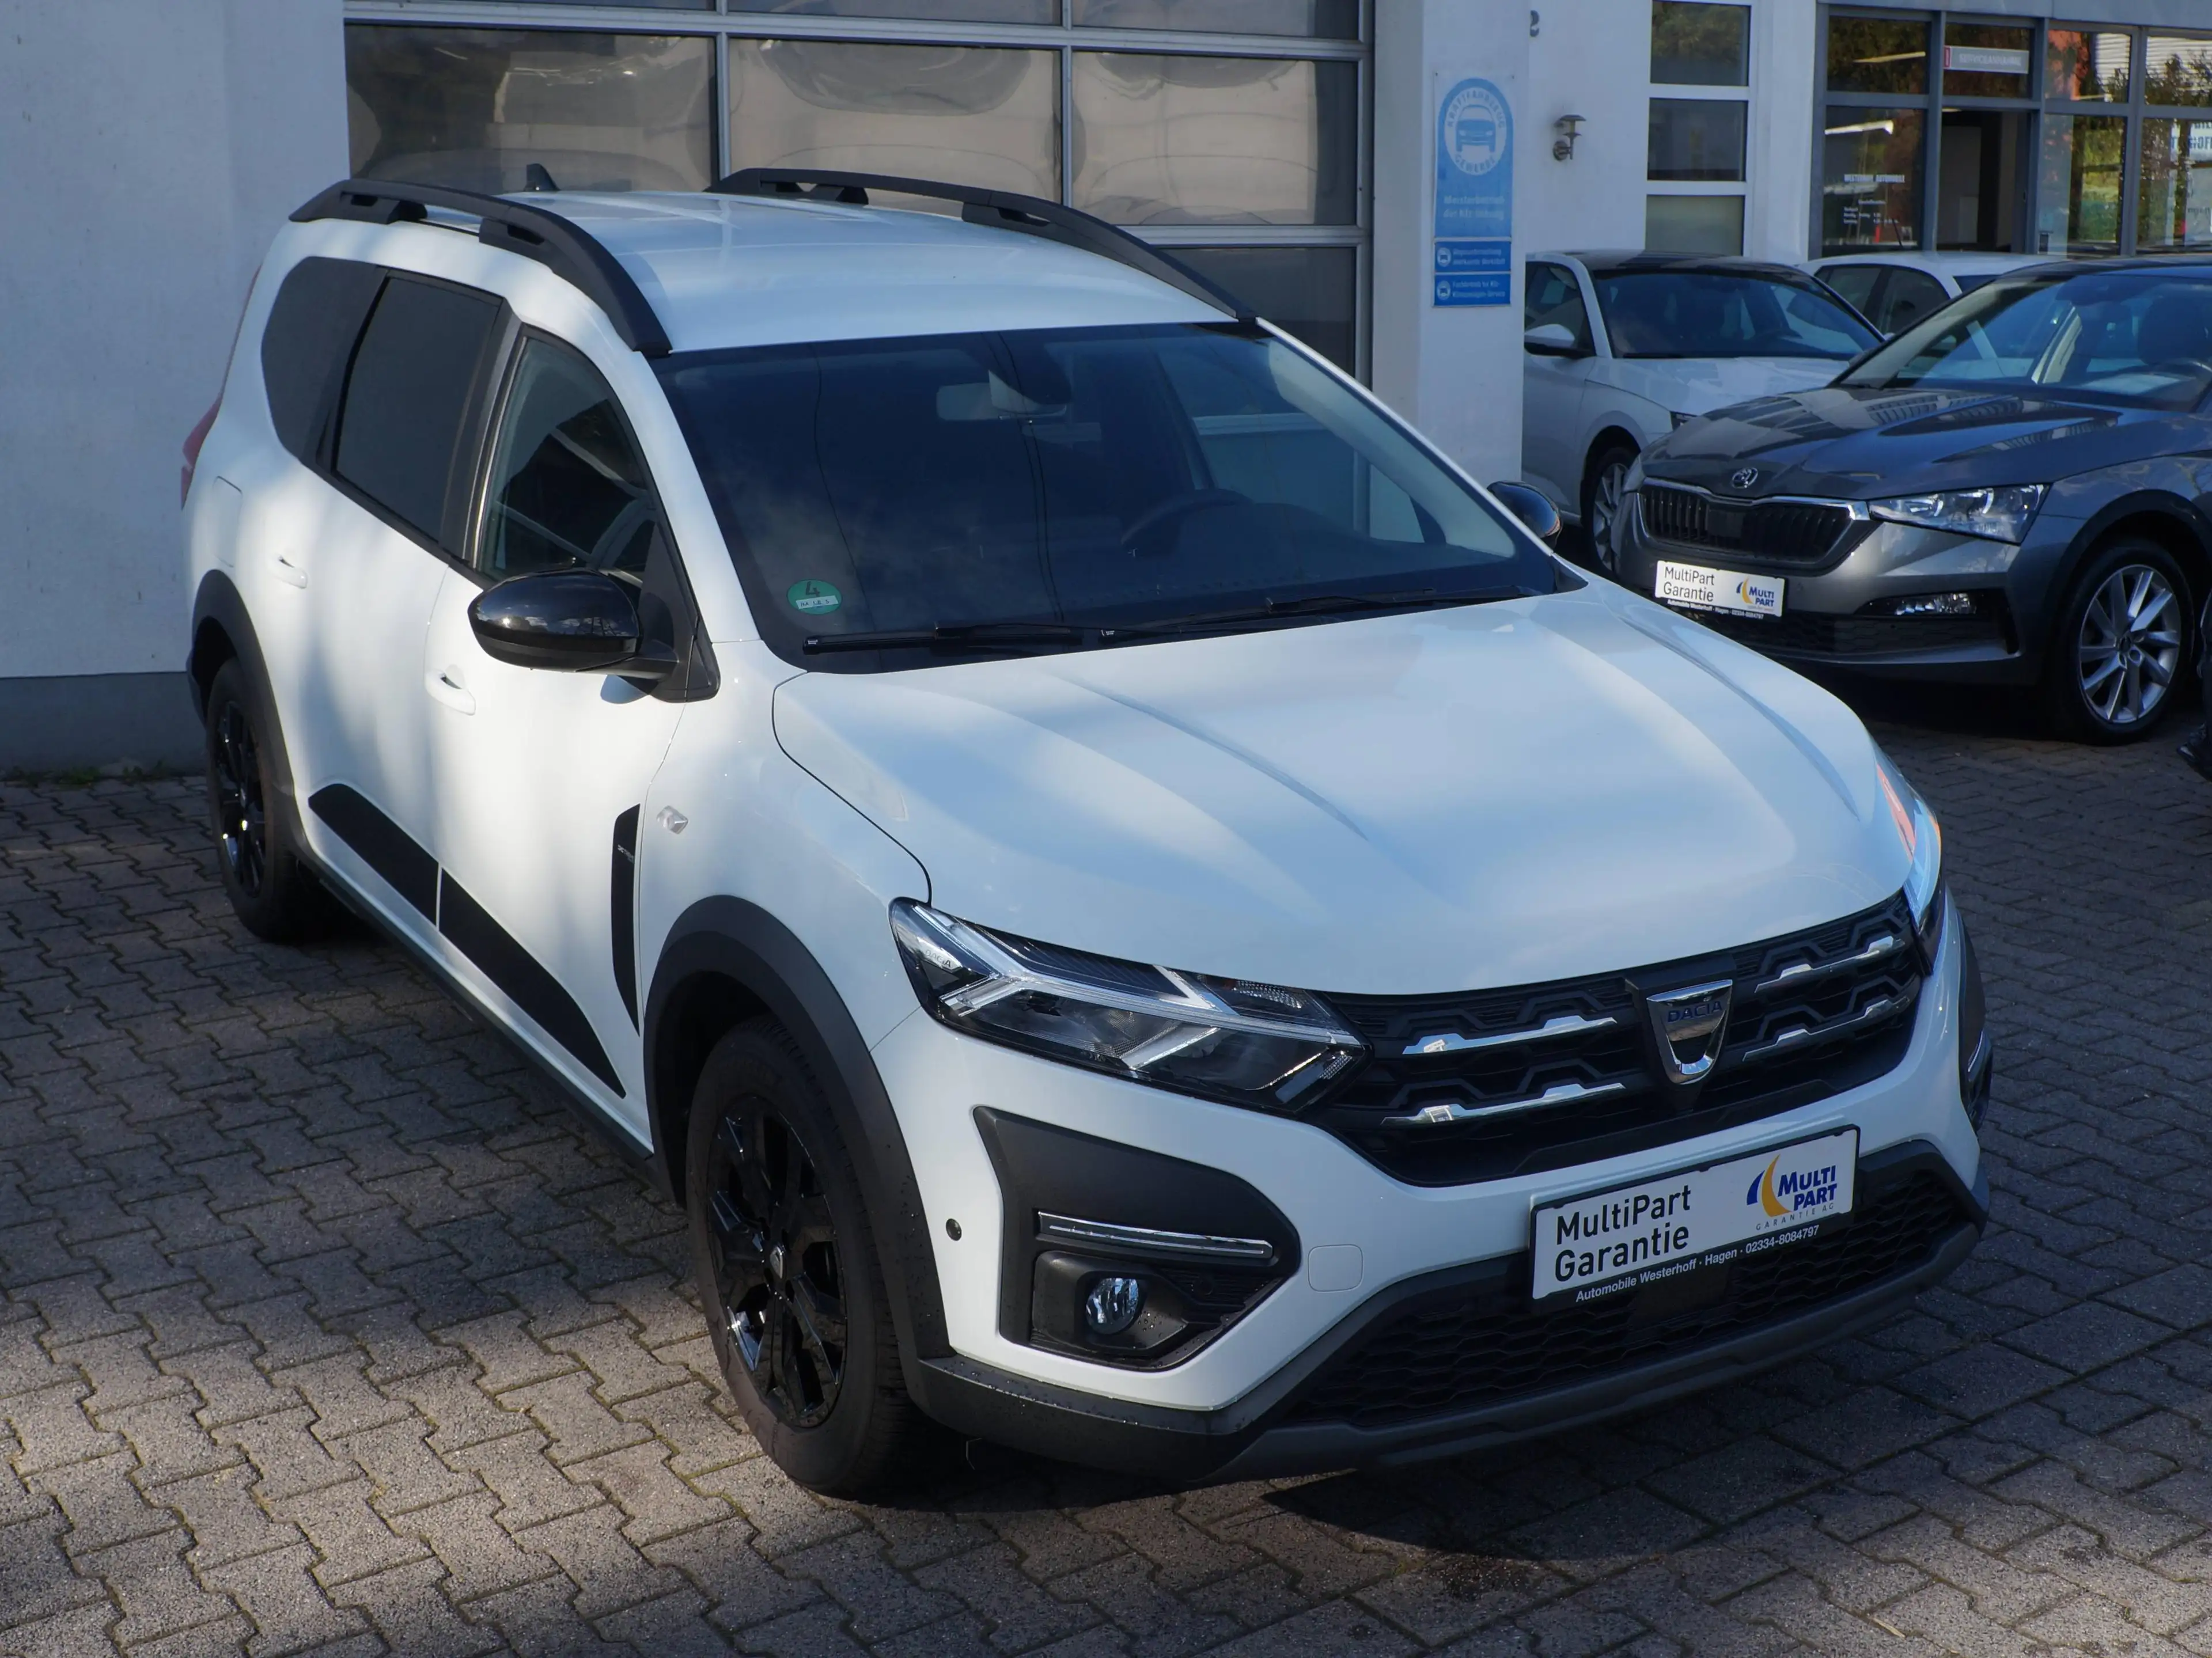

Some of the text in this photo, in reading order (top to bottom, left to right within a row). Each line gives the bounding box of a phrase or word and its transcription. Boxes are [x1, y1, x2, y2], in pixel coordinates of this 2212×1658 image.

[1664, 566, 1715, 586] MultiPart
[805, 581, 820, 597] 4
[1663, 582, 1714, 602] Garantie
[1748, 586, 1774, 599] MULTI
[1755, 597, 1775, 607] PART
[925, 949, 951, 968] DACIA
[1667, 1000, 1722, 1023] DACIA
[1778, 1165, 1836, 1197] MULTI
[1793, 1183, 1838, 1211] PART
[1556, 1185, 1691, 1245] MultiPart
[1756, 1202, 1834, 1231] GARANTIE AG
[1555, 1221, 1690, 1282] Garantie
[1575, 1224, 1820, 1303] Automobile Westerhoff Hagen 02334-8084797
